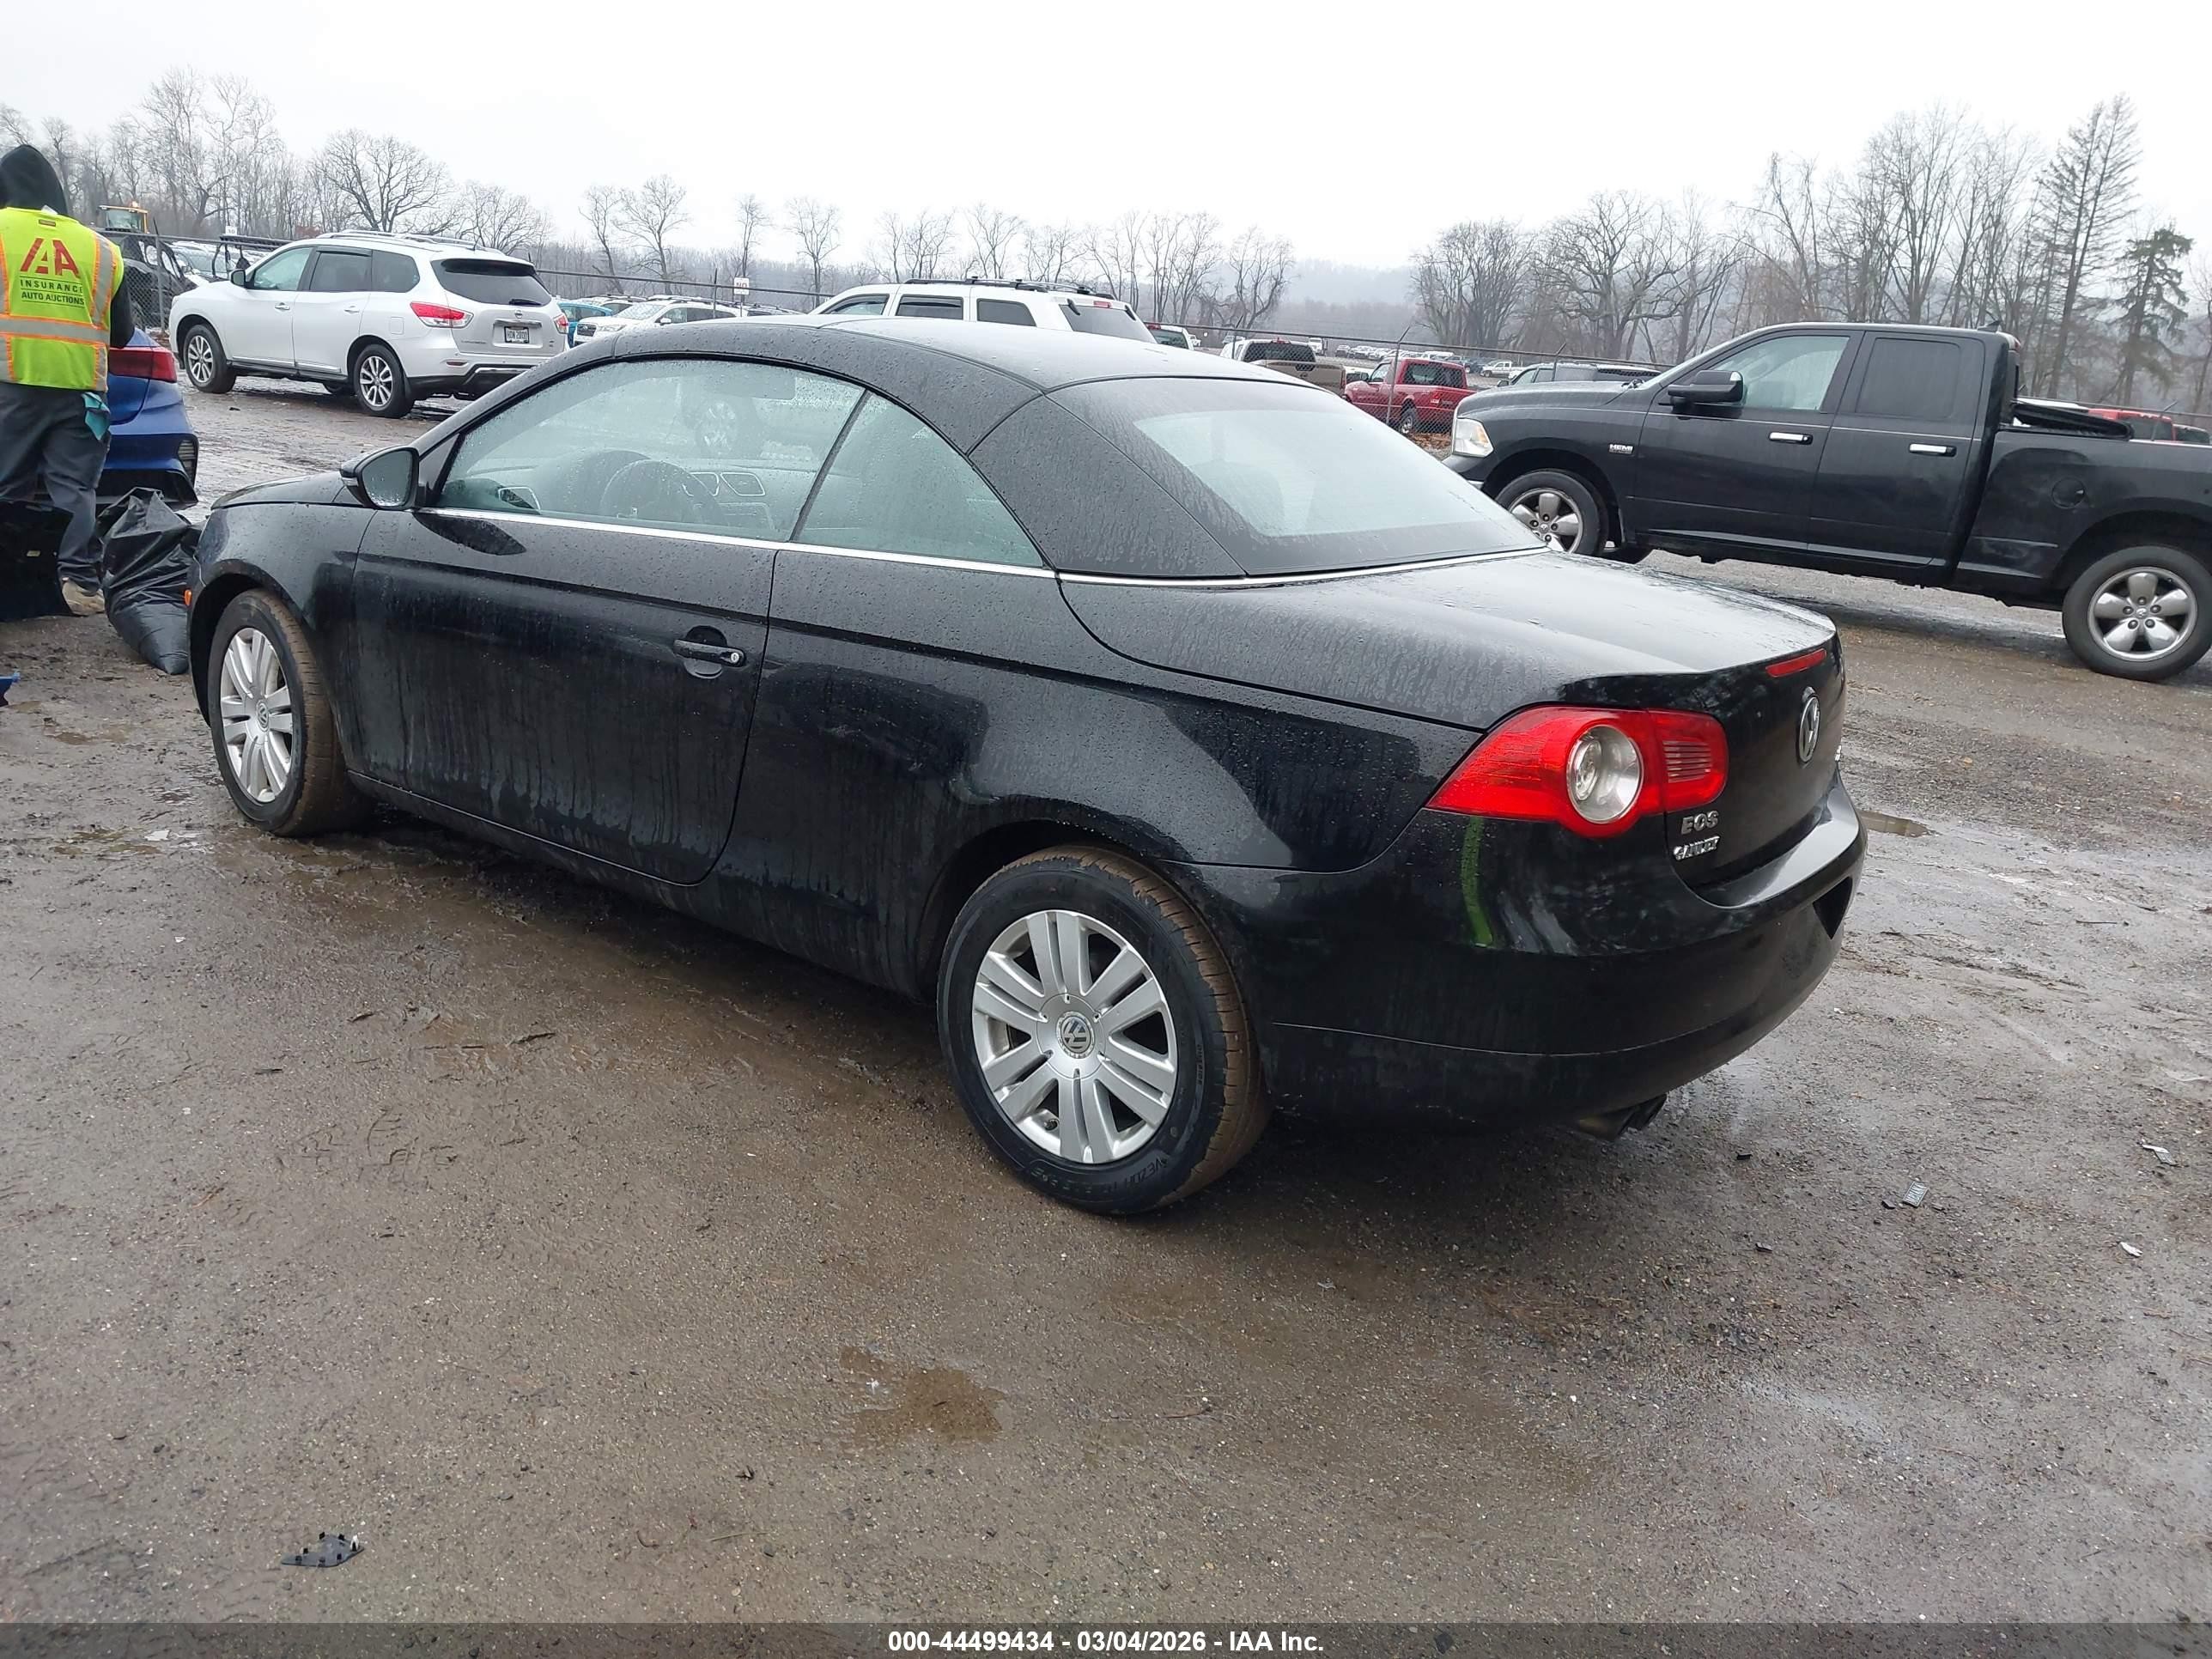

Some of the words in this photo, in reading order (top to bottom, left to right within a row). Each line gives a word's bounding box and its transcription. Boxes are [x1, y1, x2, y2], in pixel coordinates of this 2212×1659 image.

[20, 279, 83, 294] INSURANCE
[21, 291, 44, 301] AUTO
[46, 294, 85, 305] AUCTIONS
[1609, 443, 1633, 452] HEMI
[1681, 810, 1719, 835] EOS
